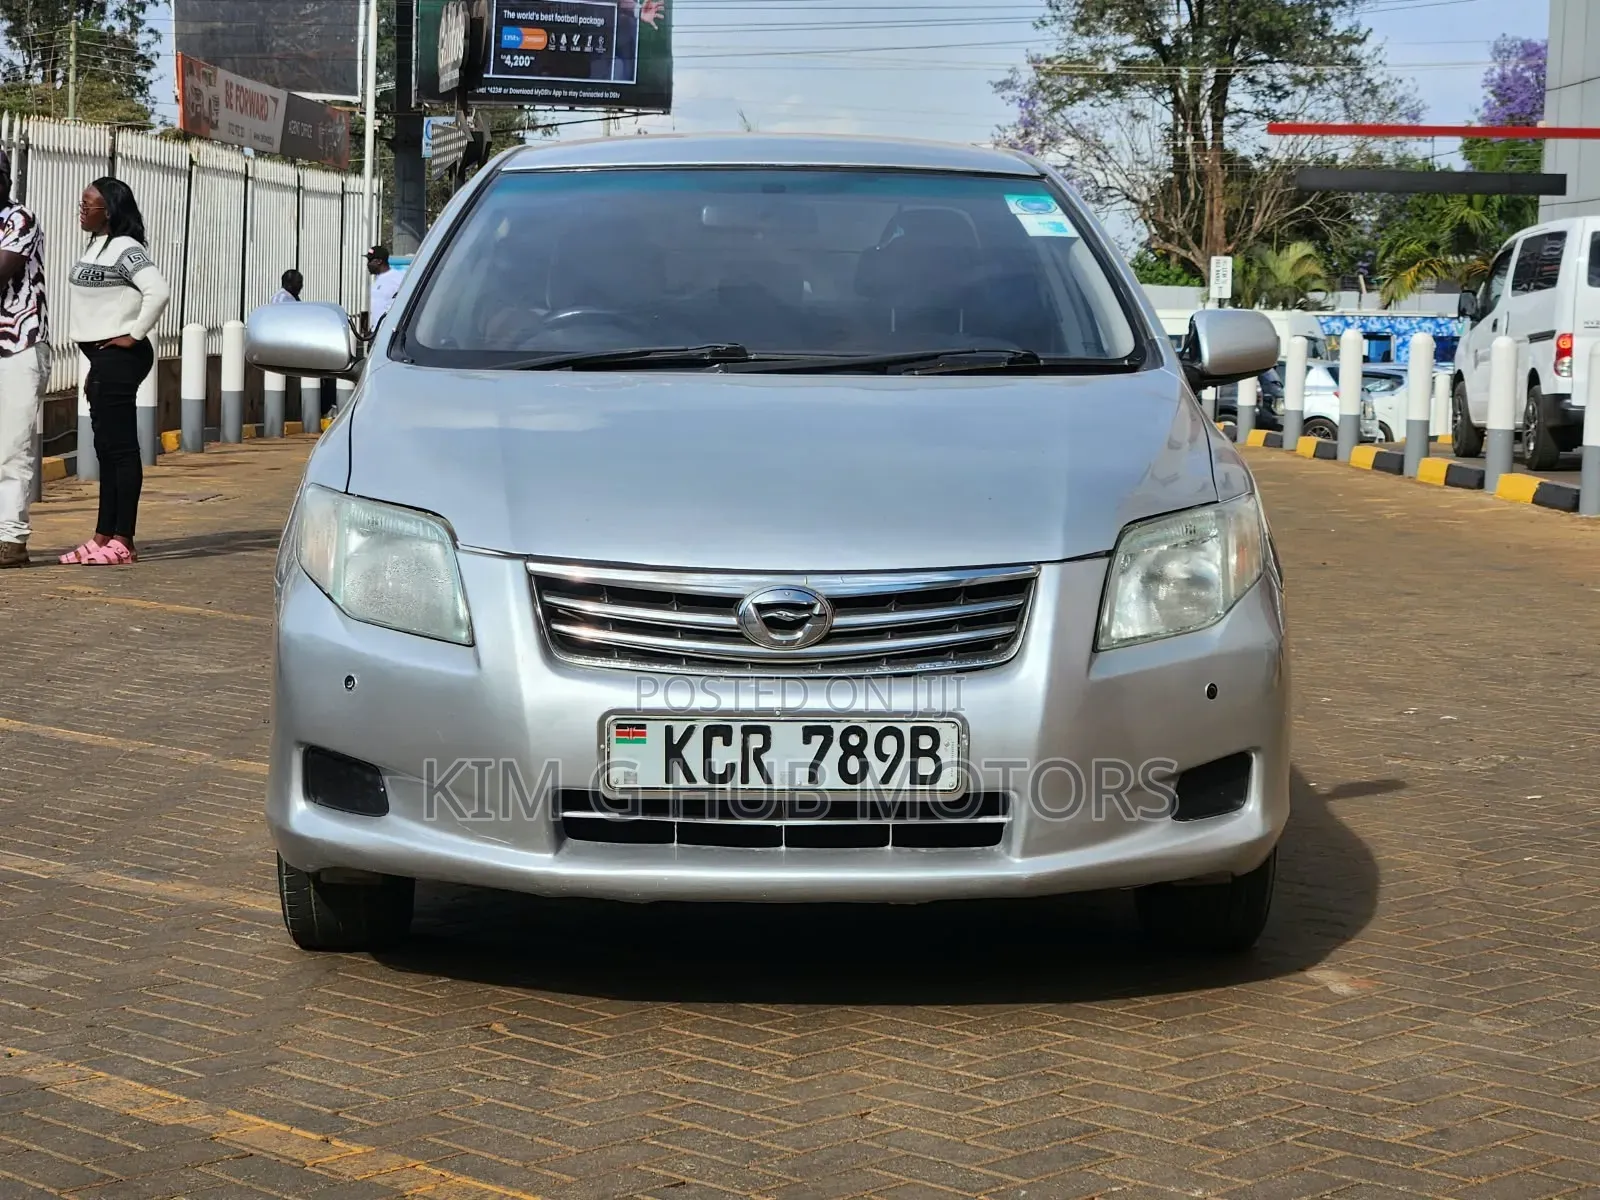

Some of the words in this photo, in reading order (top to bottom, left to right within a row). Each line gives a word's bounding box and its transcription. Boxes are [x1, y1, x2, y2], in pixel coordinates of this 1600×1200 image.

[503, 10, 516, 19] The
[516, 11, 539, 20] world's
[540, 12, 554, 21] best
[555, 13, 579, 23] football
[579, 15, 605, 27] package
[225, 80, 234, 110] BE
[235, 85, 269, 122] FORWARD
[509, 87, 534, 95] Download
[552, 89, 563, 97] App
[568, 90, 578, 98] stay
[579, 90, 603, 98] Connected
[301, 121, 313, 139] OFFICE
[664, 724, 773, 785] KCR
[801, 724, 943, 785] 789B
